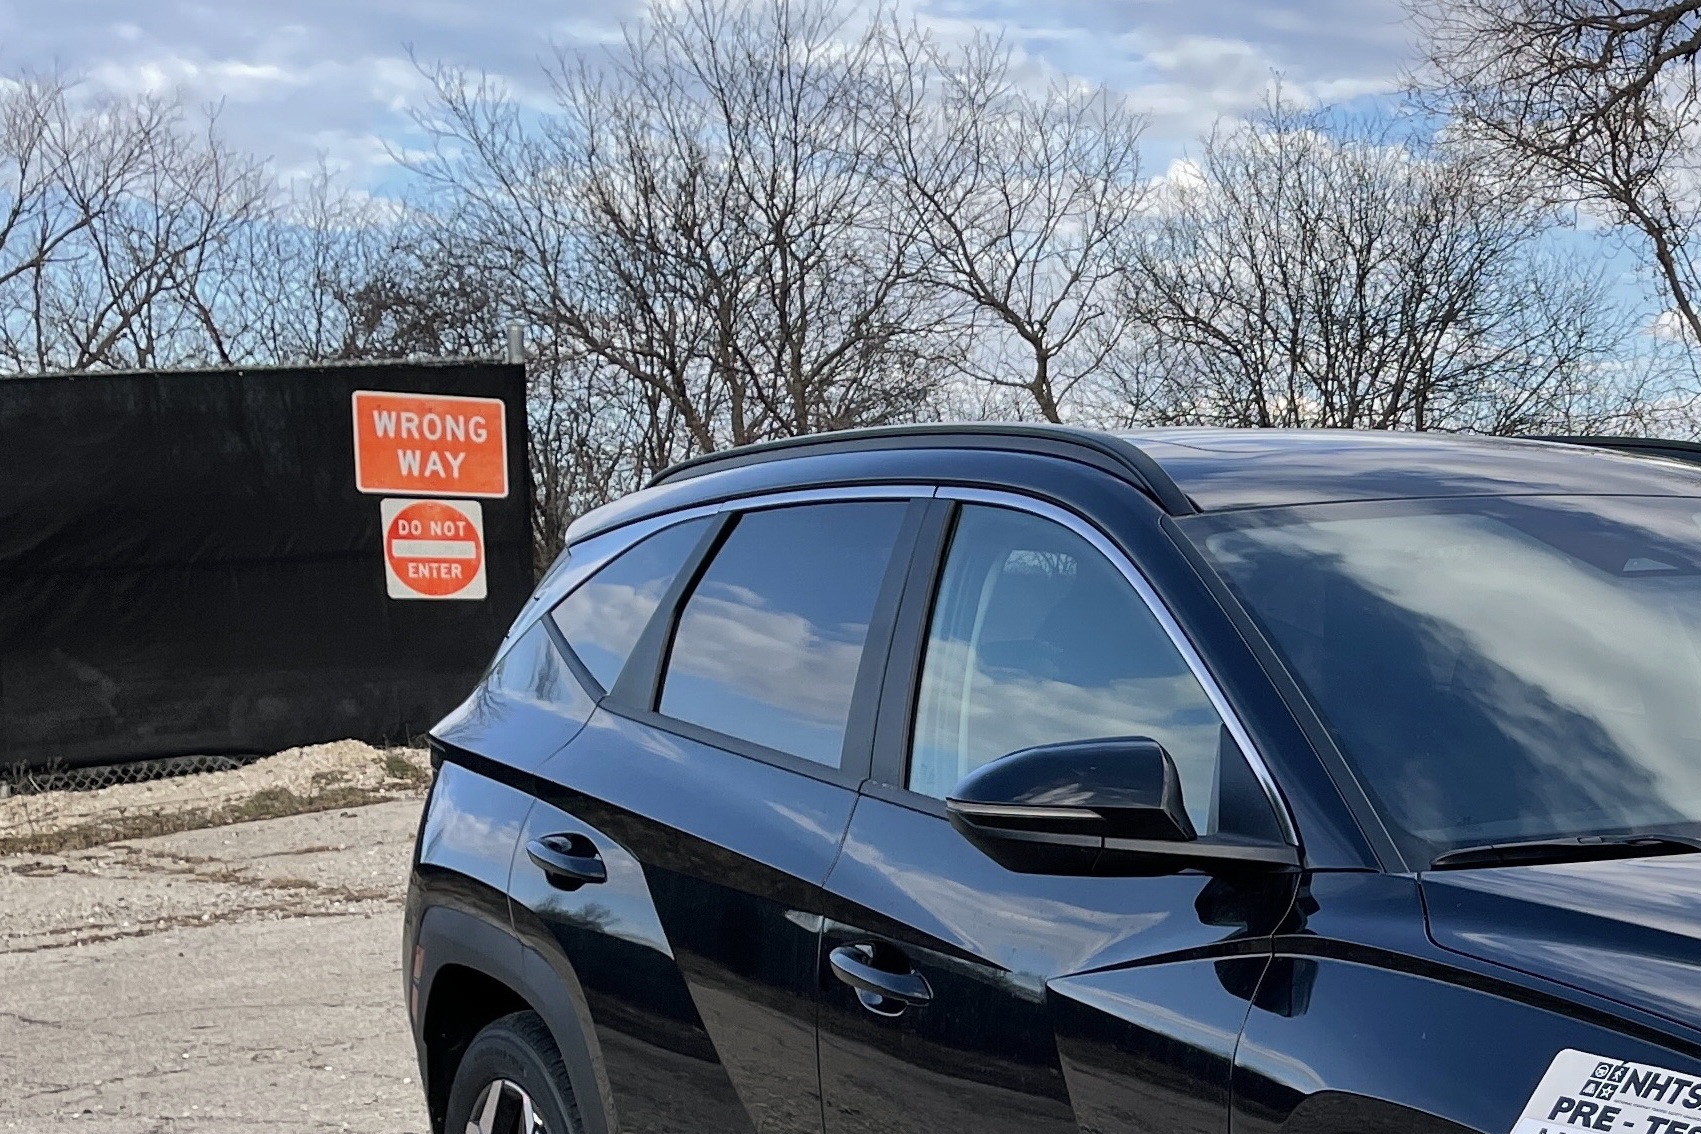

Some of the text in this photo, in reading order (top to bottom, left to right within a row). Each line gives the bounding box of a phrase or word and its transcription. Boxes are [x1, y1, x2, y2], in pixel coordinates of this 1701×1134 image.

[372, 410, 488, 443] WRONG
[397, 449, 466, 479] WAY
[398, 519, 466, 537] DO NOT
[408, 562, 462, 579] ENTER
[1547, 1096, 1622, 1132] PRE
